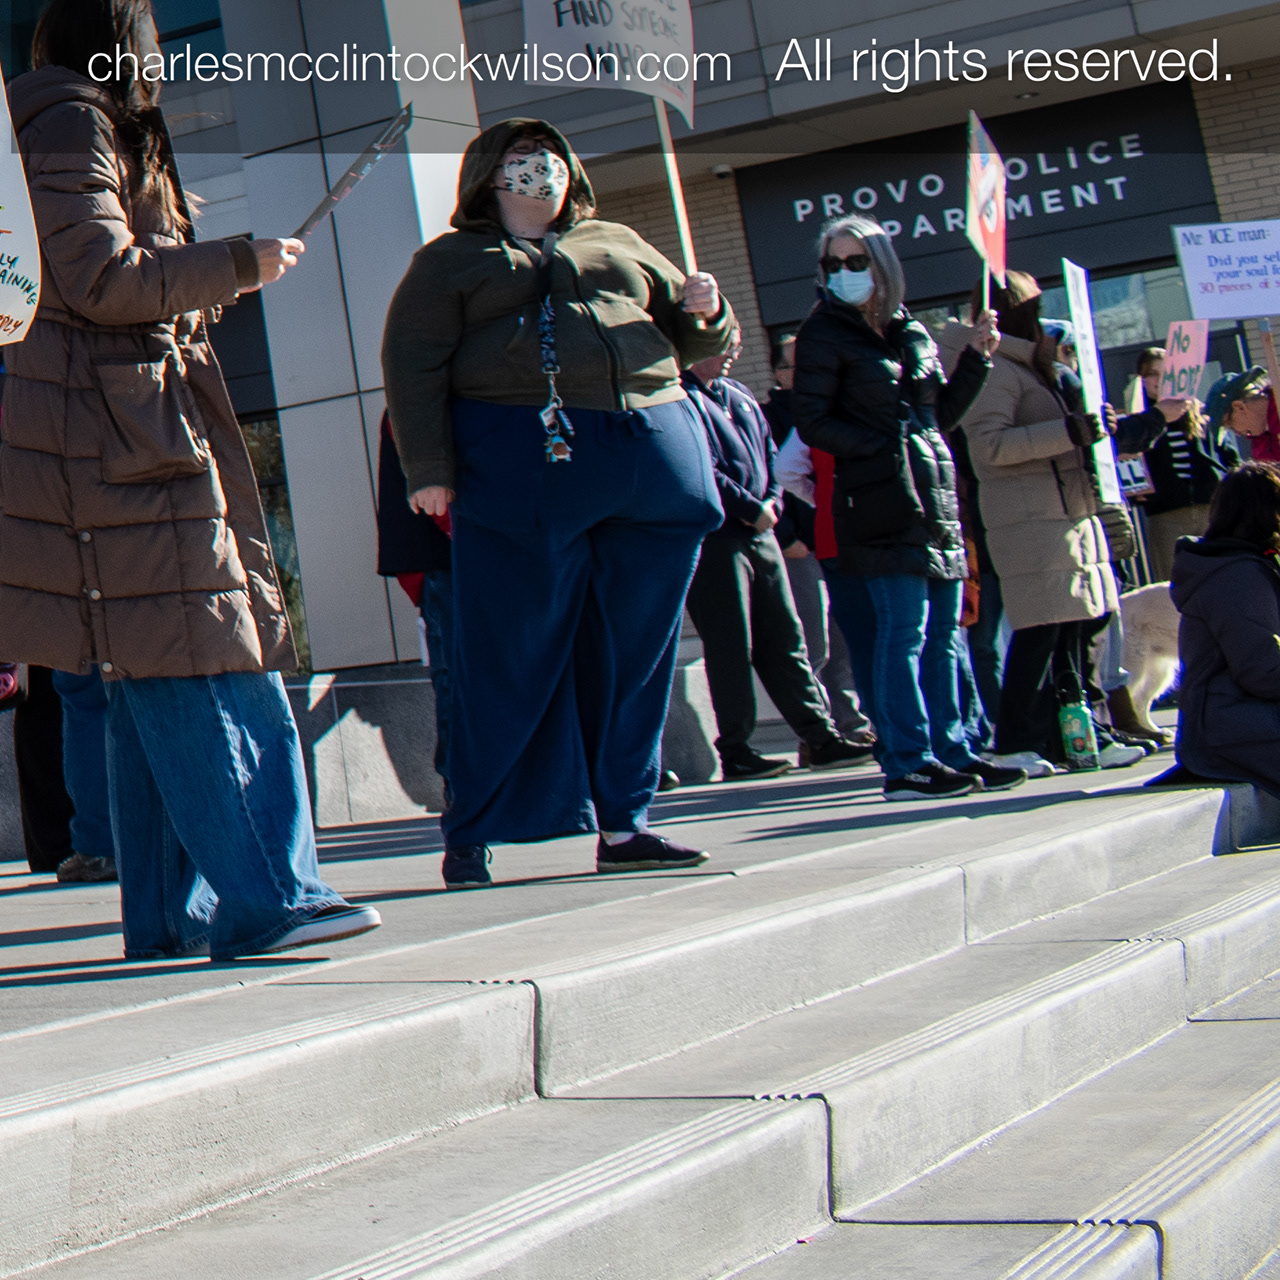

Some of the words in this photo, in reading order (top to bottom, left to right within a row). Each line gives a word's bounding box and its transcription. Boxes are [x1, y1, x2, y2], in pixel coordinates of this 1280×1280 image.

[793, 173, 944, 222] PROVO
[1003, 133, 1144, 181] OLICE
[880, 175, 1127, 240] PARMENT
[1208, 228, 1234, 244] ICE
[1206, 253, 1233, 268] Did
[1235, 254, 1259, 268] you
[1213, 269, 1243, 283] your
[1246, 264, 1268, 277] soul
[1169, 324, 1191, 357] No
